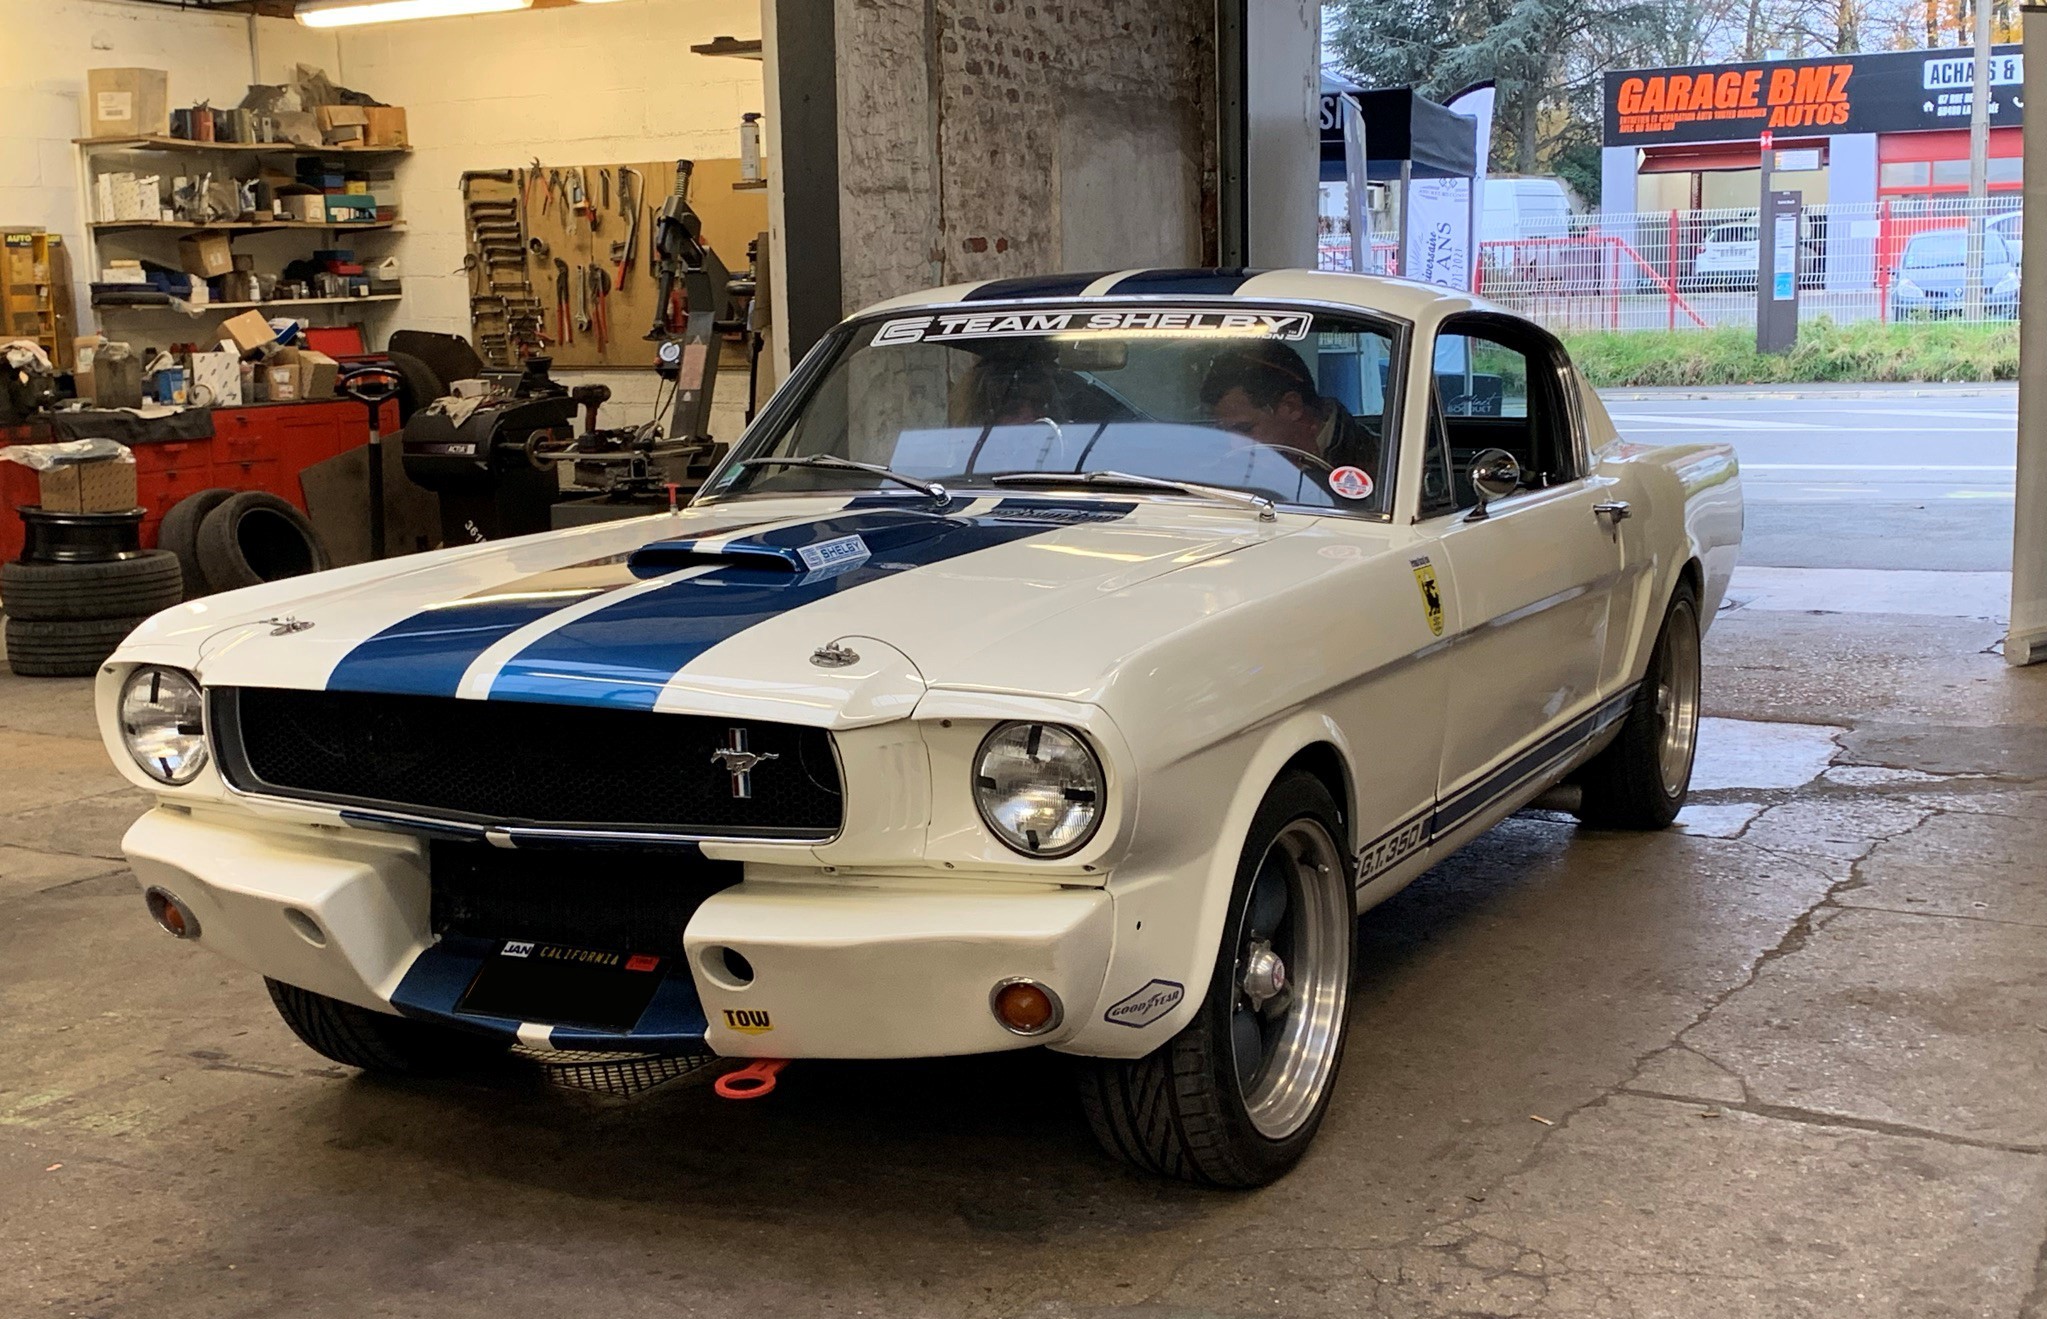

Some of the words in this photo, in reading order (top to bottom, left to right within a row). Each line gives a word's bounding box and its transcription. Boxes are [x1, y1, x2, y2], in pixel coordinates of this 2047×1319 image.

[1930, 62, 1996, 84] ACHAS
[1617, 70, 1763, 115] GARAGE
[1767, 65, 1853, 105] BMZ
[1768, 103, 1850, 128] AUTOS
[1423, 231, 1437, 282] iversaire
[1436, 222, 1453, 271] ANS
[940, 315, 1073, 335] TEAM
[1087, 313, 1298, 333] SHELBY
[820, 541, 859, 559] SHELBY
[505, 945, 533, 955] JAN
[540, 947, 619, 966] CALIFORNIA
[1111, 990, 1180, 1016] GOODYEAR
[722, 1009, 770, 1026] TOW
